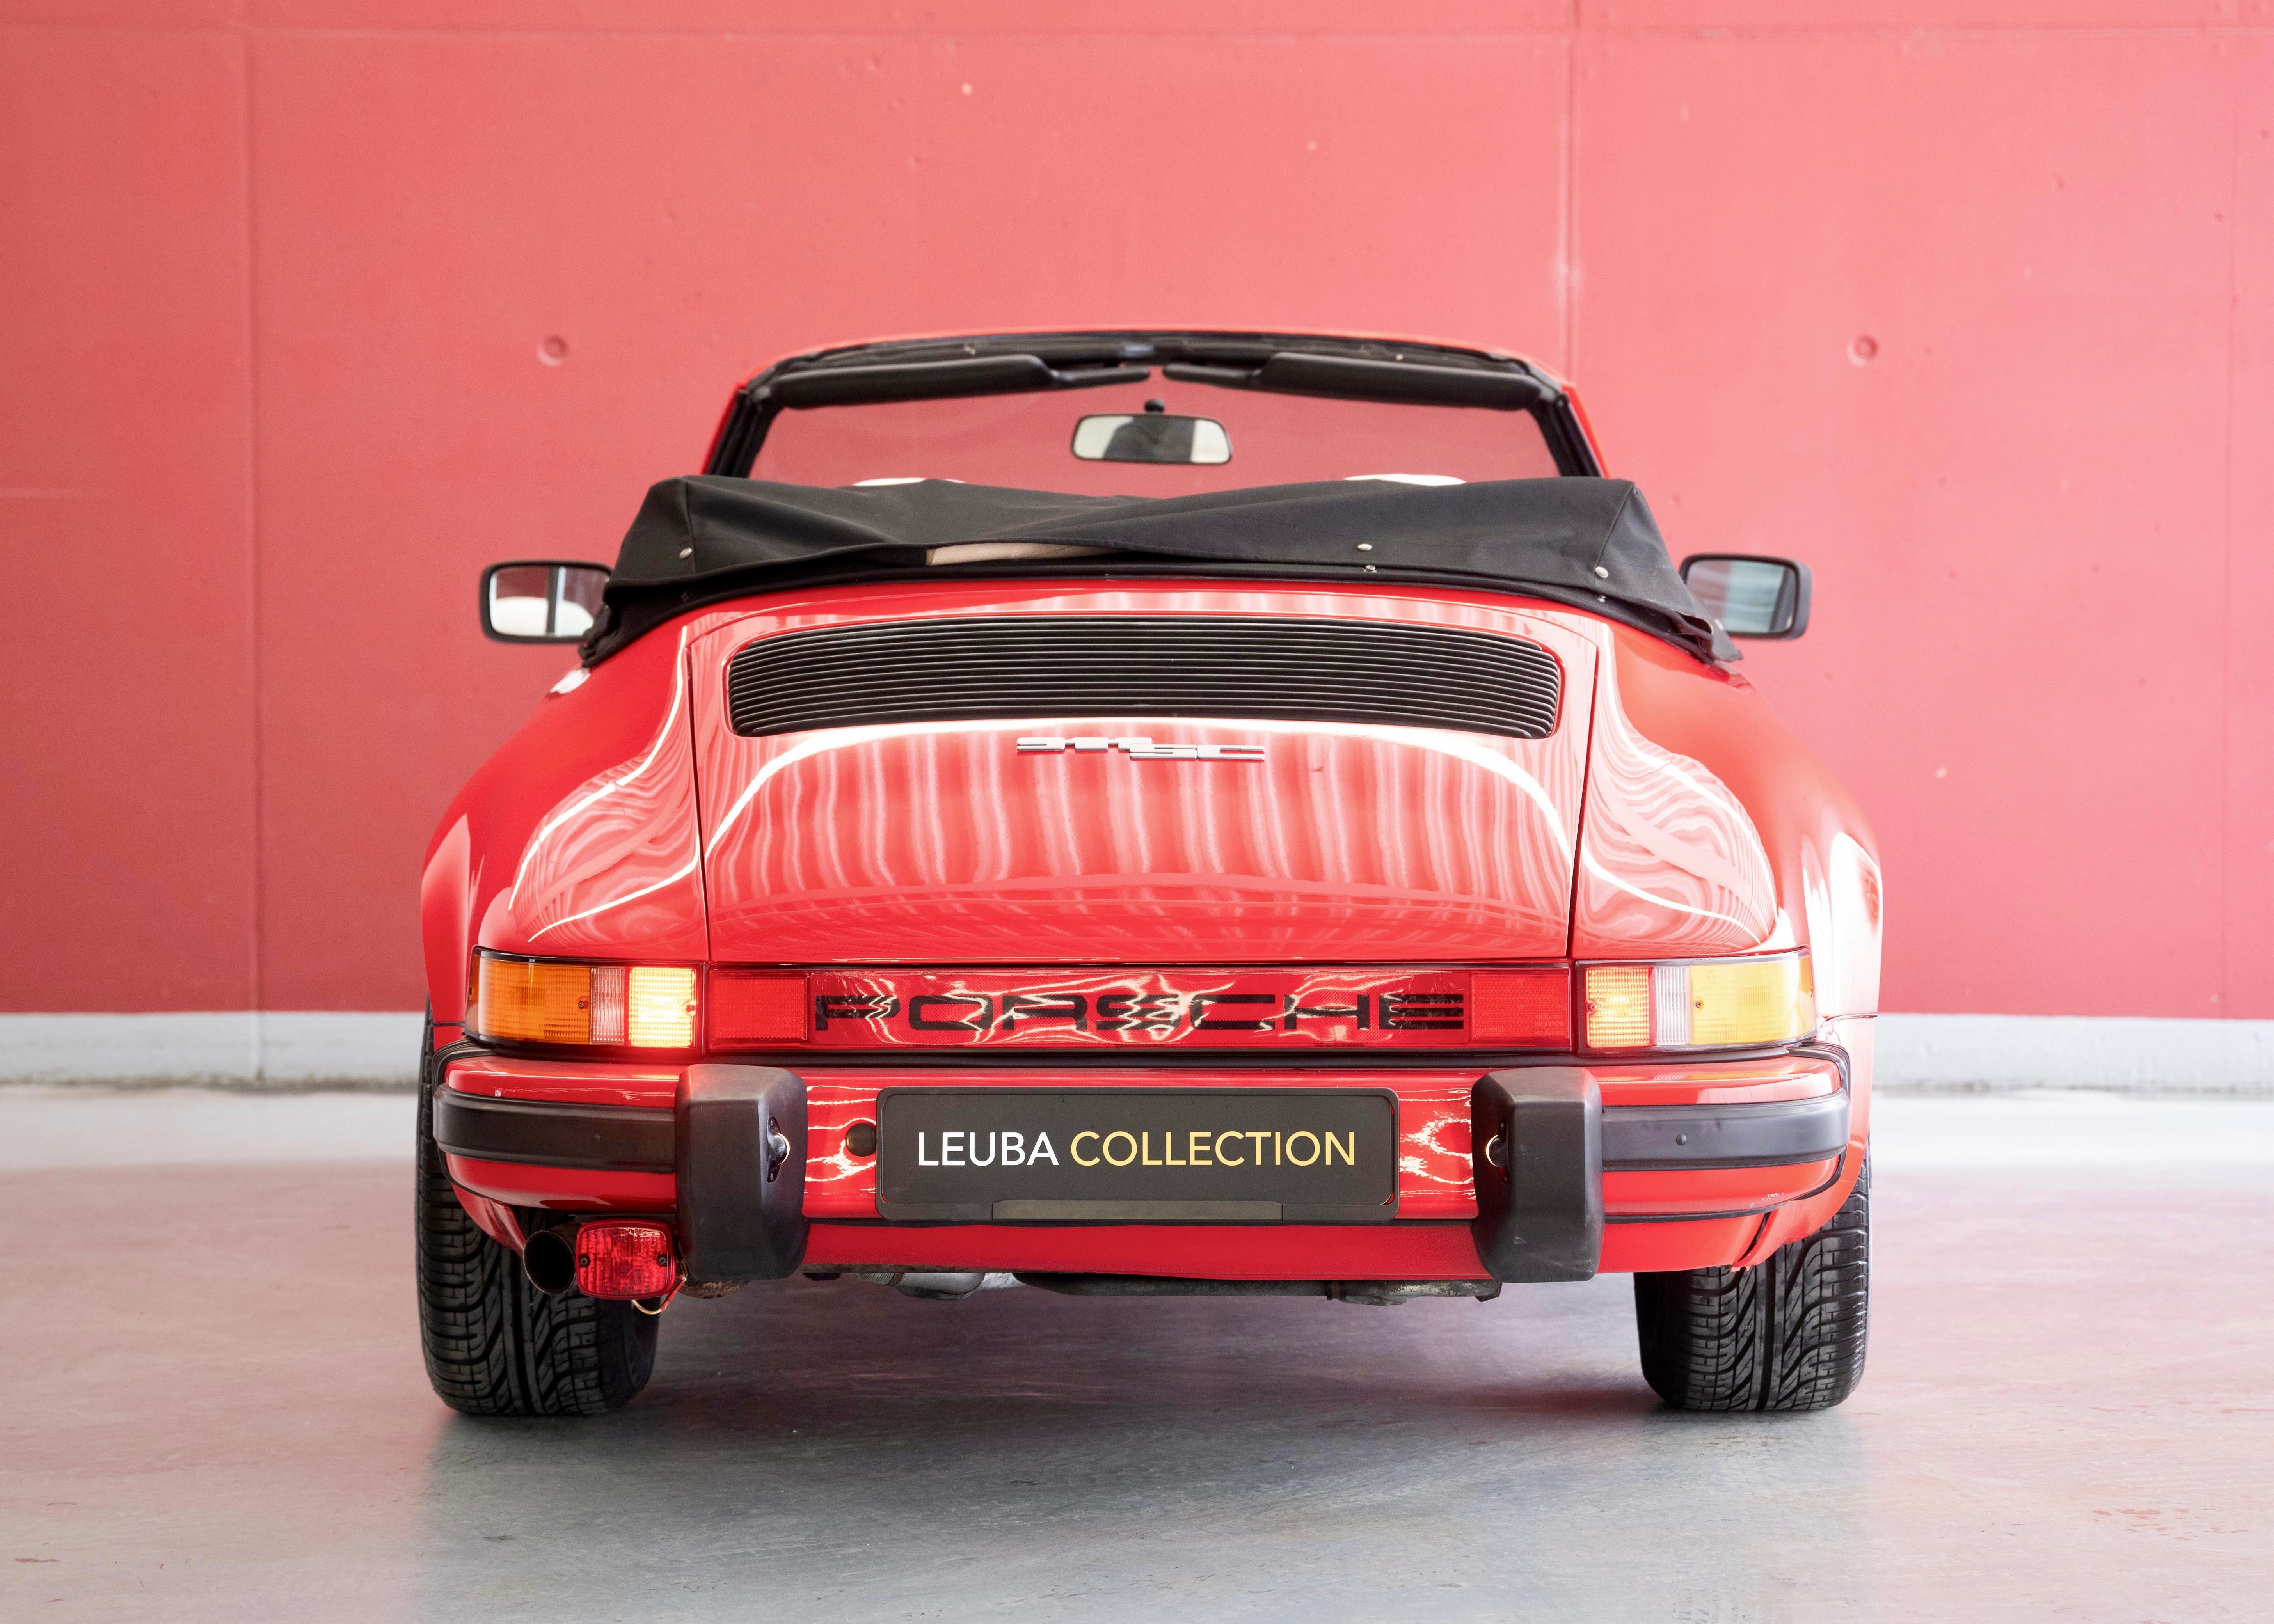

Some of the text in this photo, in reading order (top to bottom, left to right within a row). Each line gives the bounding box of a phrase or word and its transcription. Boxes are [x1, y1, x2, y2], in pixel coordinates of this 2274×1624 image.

[816, 994, 1464, 1031] PORSCHE
[918, 1131, 1355, 1166] LEUBA COLLECTION
